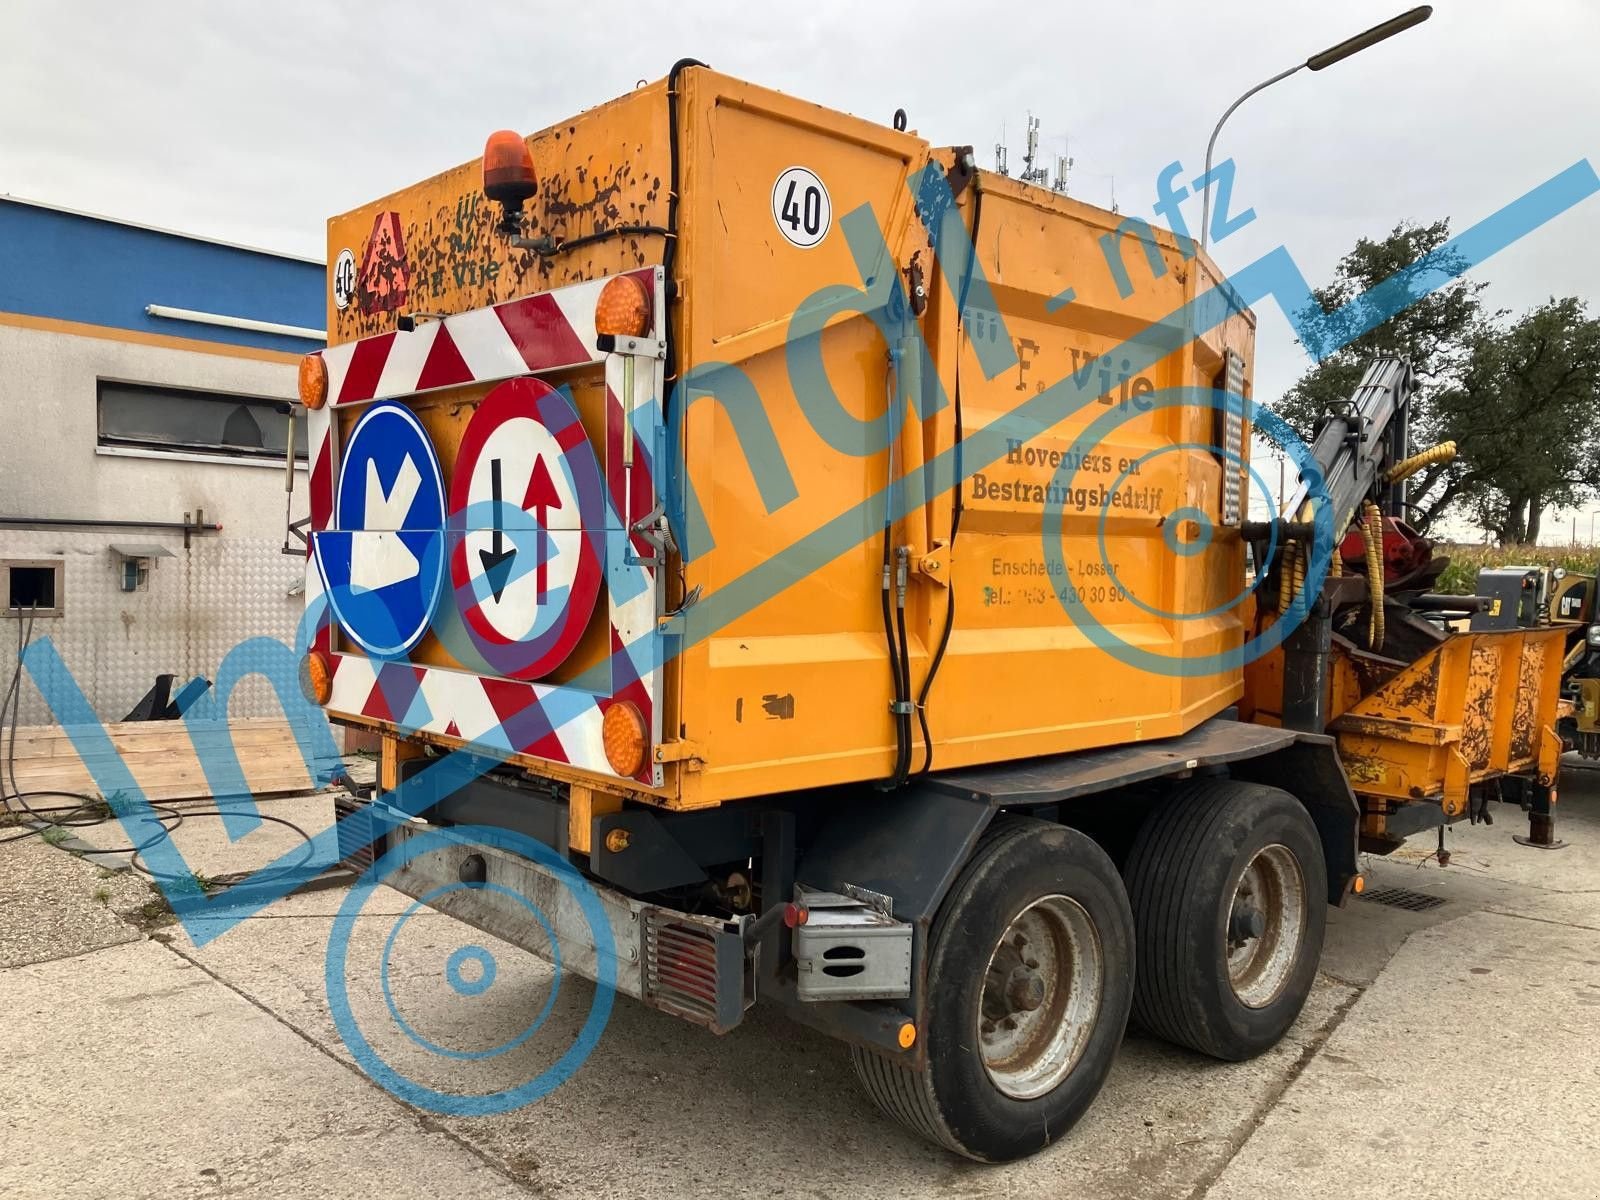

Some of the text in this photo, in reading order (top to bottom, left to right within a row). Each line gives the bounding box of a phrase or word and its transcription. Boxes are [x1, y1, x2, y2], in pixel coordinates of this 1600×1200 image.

[780, 179, 821, 237] 40
[335, 258, 354, 298] 40
[452, 258, 500, 289] Vije
[1064, 345, 1155, 412] Vije
[1006, 437, 1142, 476] Hoveniers en
[971, 473, 1164, 514] Bestratingsbedrijf
[992, 558, 1064, 576] Enschede
[1077, 559, 1120, 576] Losser
[1059, 586, 1086, 604] 430
[1089, 586, 1106, 604] 30
[1108, 585, 1127, 603] 90
